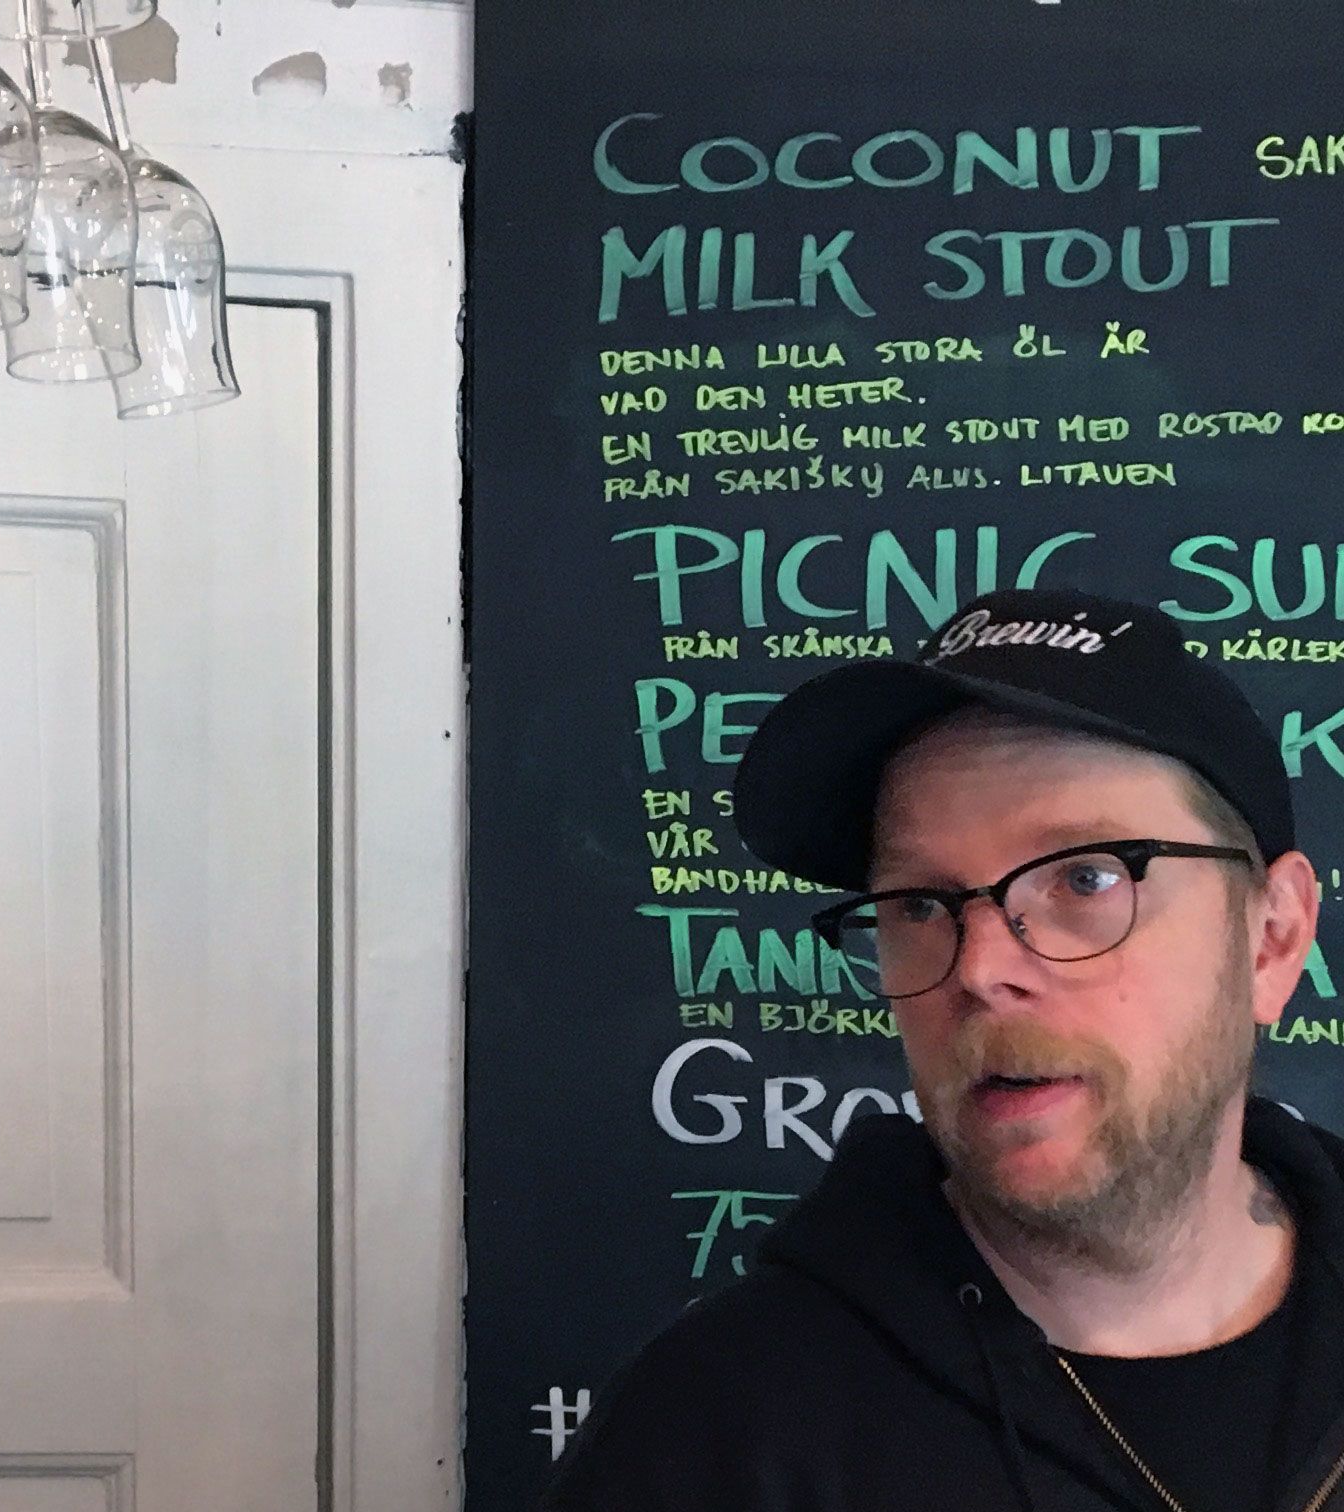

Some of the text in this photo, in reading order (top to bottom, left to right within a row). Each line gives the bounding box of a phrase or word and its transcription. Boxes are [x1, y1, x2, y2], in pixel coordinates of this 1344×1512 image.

[592, 112, 1203, 196] COCONUT
[598, 217, 1281, 325] MILK STOUT
[599, 344, 726, 377] DENNA
[880, 338, 983, 364] STORA
[1012, 323, 1067, 360] ÖL
[1101, 320, 1150, 359] ÄR
[600, 376, 928, 415] VAD DEN HETER.
[602, 431, 652, 466] EN
[676, 412, 820, 460] TREVLIG
[841, 422, 928, 449] MILK
[944, 417, 1041, 445] STOUT
[1057, 415, 1130, 443] MED
[1158, 410, 1284, 439] ROSTAD
[603, 470, 691, 502] FRÅN
[662, 629, 740, 662] FRÅN
[762, 627, 894, 660] SKÅNSKA
[641, 788, 691, 820] EN
[646, 821, 720, 860] VÅR
[678, 1000, 735, 1030] EN
